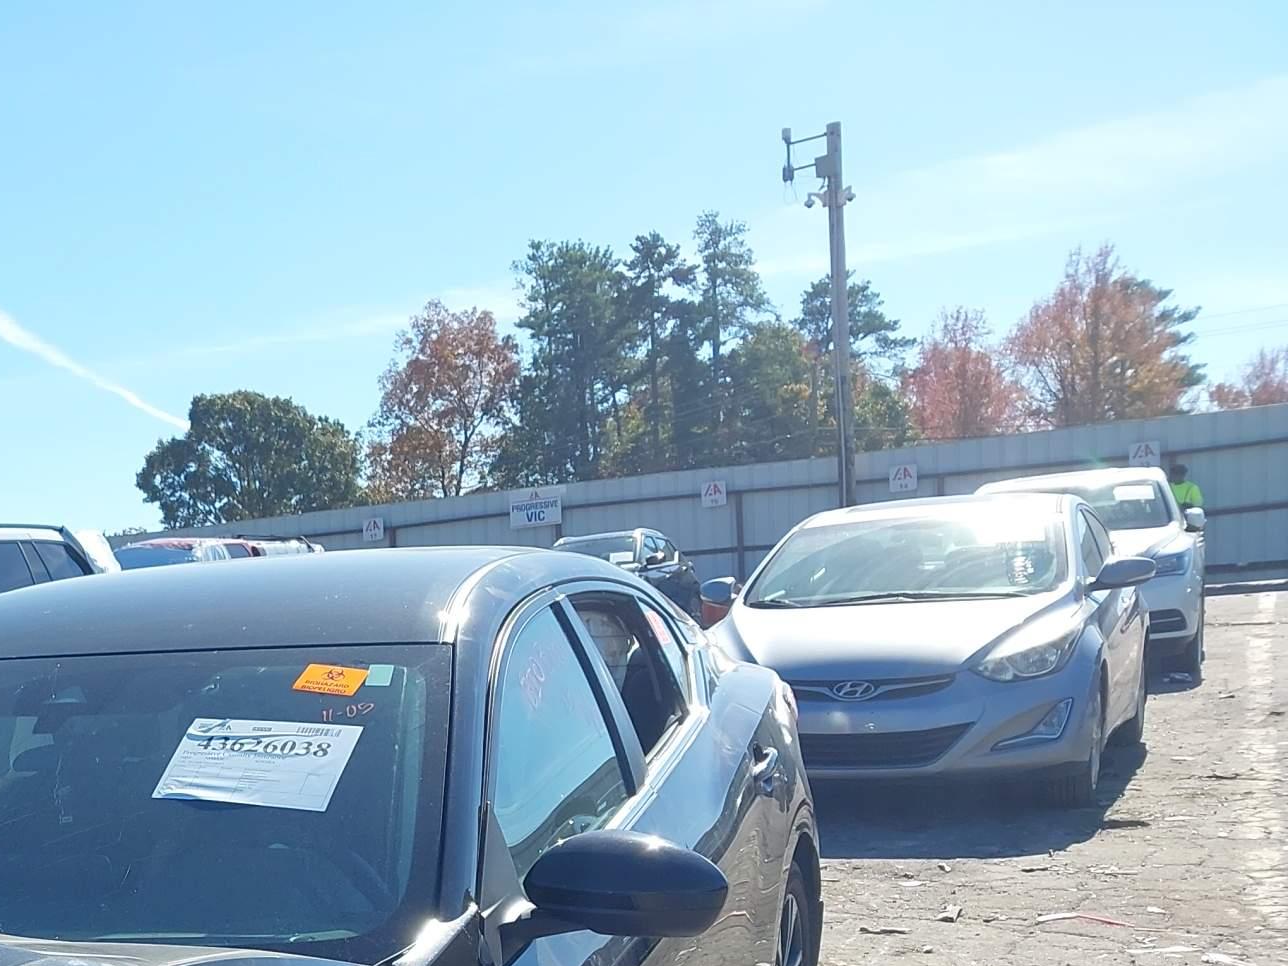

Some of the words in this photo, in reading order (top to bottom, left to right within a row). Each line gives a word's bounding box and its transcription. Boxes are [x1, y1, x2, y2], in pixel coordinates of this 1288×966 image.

[512, 500, 558, 512] PROGRESSIVE
[526, 510, 545, 522] VIC
[305, 679, 350, 689] BIOHAZARD
[197, 736, 332, 758] 43626038
